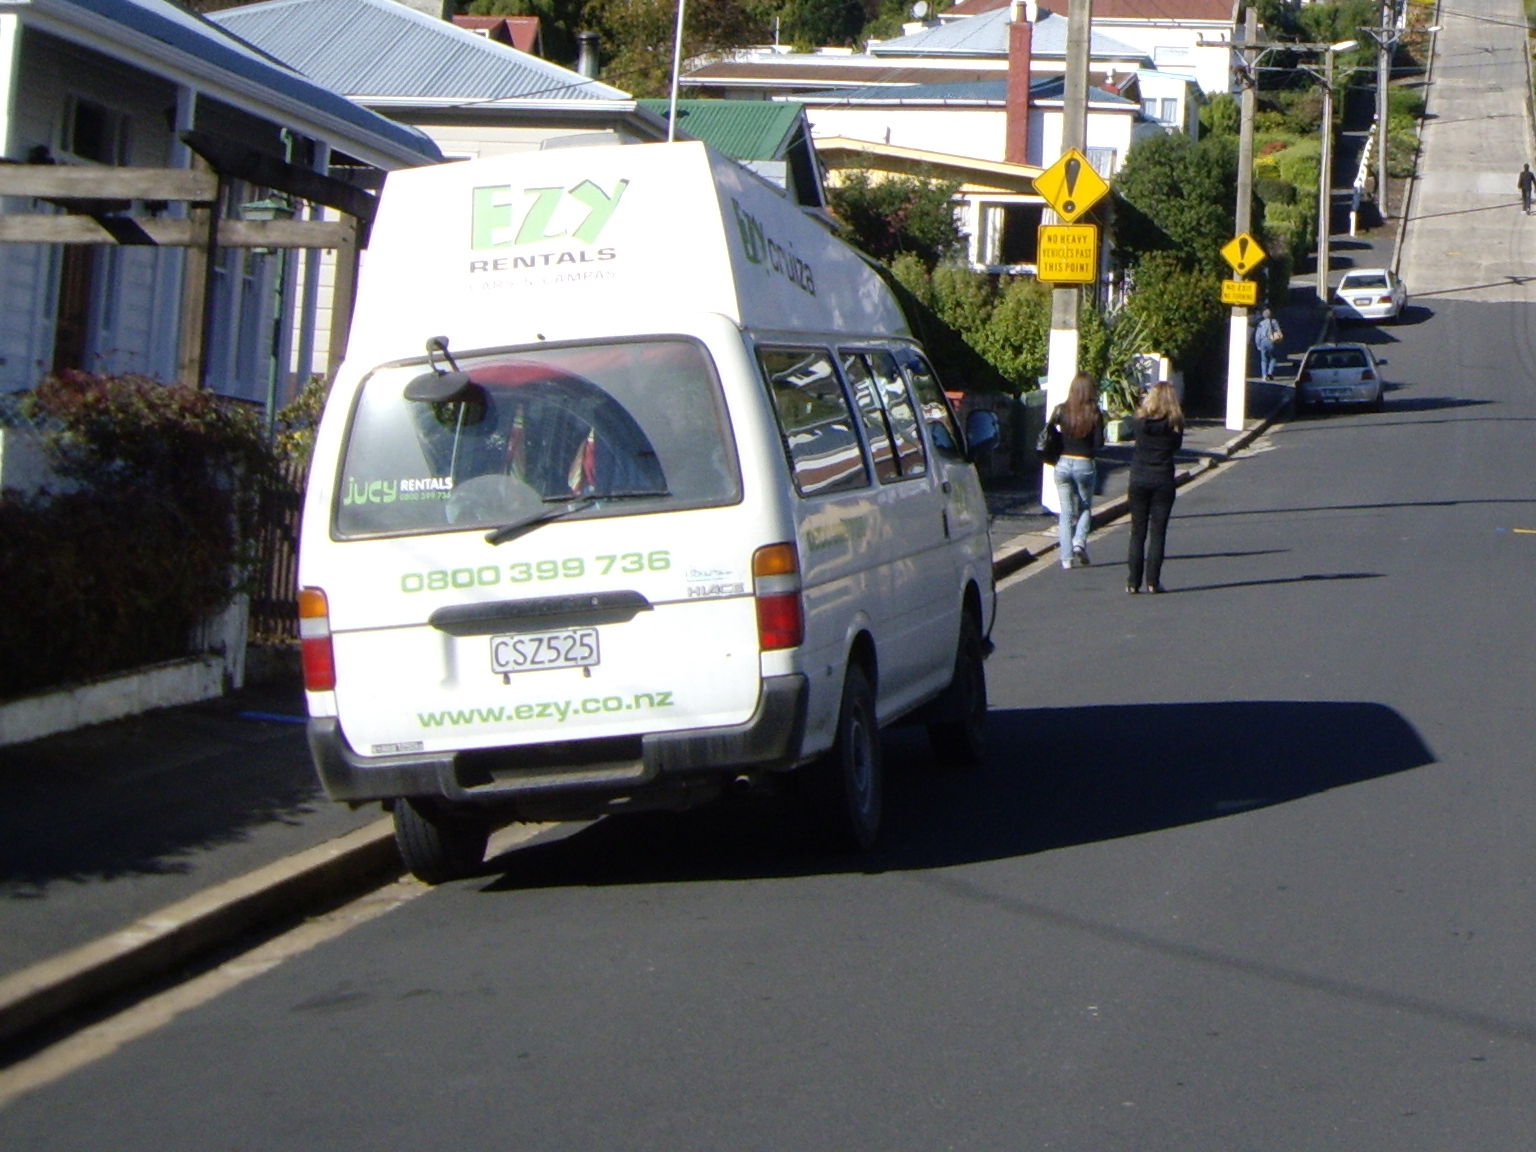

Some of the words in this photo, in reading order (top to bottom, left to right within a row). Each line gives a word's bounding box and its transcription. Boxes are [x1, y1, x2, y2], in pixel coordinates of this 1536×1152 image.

[471, 178, 630, 250] EZY
[1047, 234, 1058, 244] NO
[1060, 234, 1088, 244] HEAVY
[470, 248, 617, 273] RENTALS
[1042, 248, 1074, 258] VEHICLES
[1075, 248, 1091, 258] PAST
[1044, 262, 1063, 273] THIS
[1065, 262, 1089, 273] POINT
[400, 477, 453, 492] RENTALS
[401, 565, 501, 593] 0800
[509, 557, 585, 584] 399
[595, 550, 671, 576] 736
[495, 633, 593, 667] CSZ525
[417, 691, 674, 728] www.ezy.co.nz
